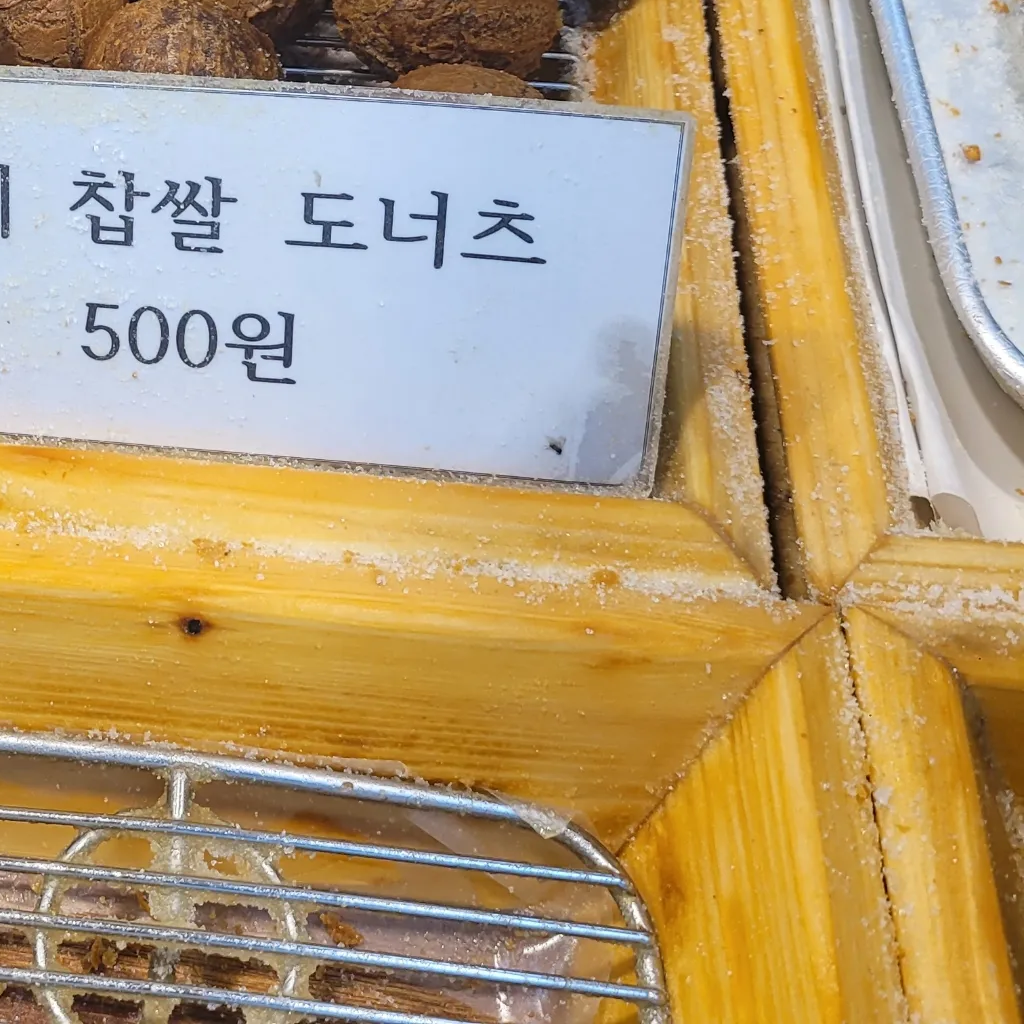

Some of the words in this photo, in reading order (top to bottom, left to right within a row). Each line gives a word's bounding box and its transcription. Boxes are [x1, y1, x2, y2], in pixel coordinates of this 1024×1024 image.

[68, 169, 238, 254] 찹쌀
[284, 190, 547, 270] 도너츠
[80, 302, 297, 385] 500원
